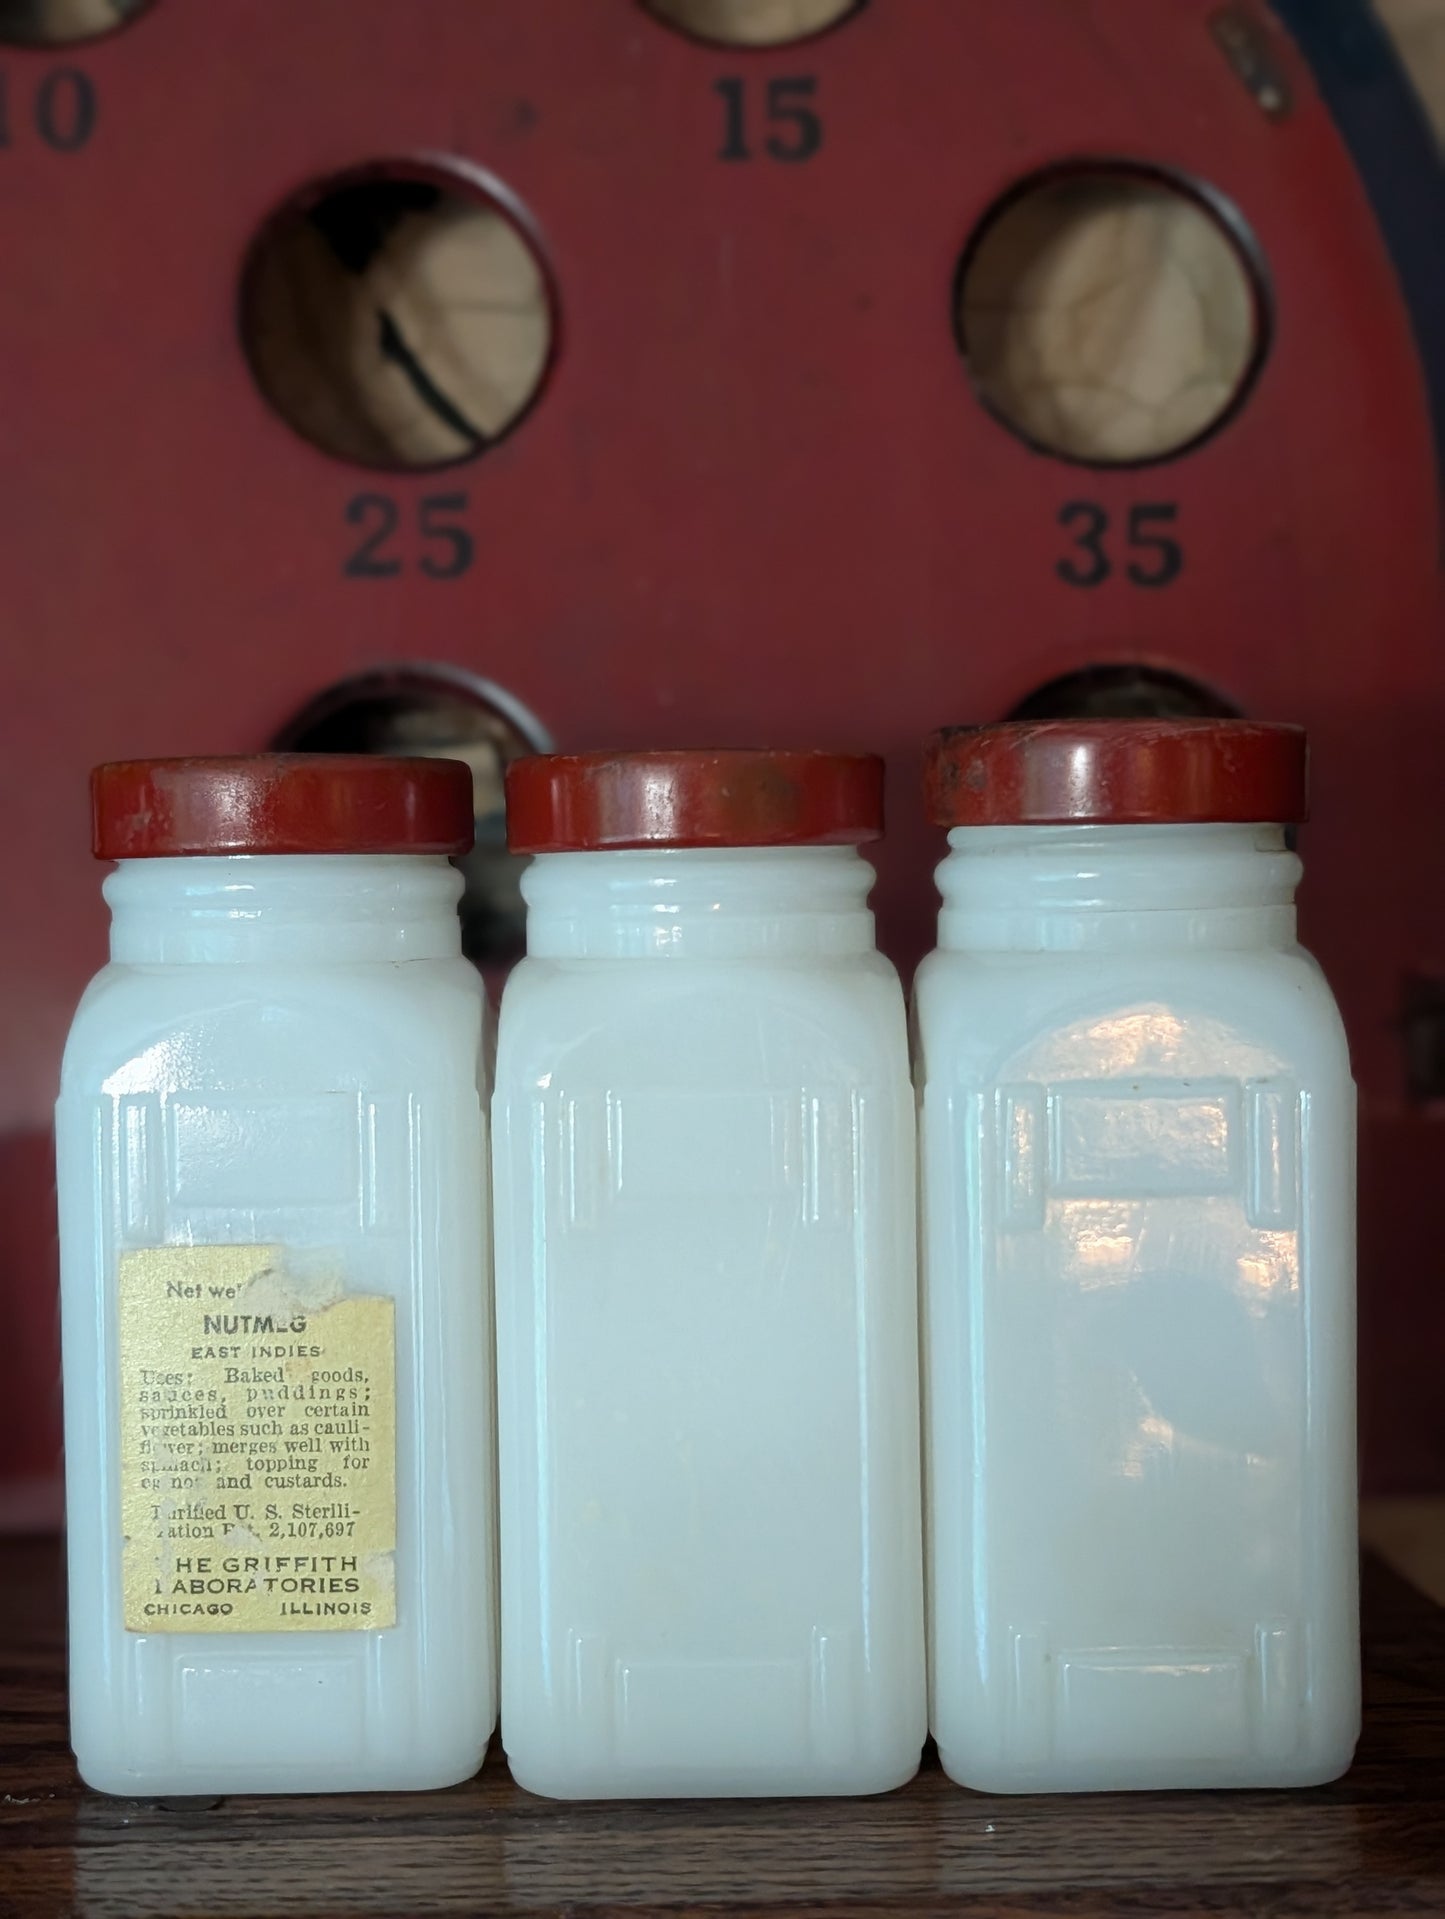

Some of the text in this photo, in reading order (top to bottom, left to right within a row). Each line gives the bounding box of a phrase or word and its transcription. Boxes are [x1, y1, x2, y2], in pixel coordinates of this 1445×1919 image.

[713, 75, 824, 163] 15
[343, 493, 475, 580] 25
[1056, 501, 1183, 587] 35
[167, 1281, 201, 1298] Net
[191, 1345, 321, 1359] EAST INDIES
[224, 1367, 283, 1384] Baked
[312, 1367, 369, 1385] goods,
[141, 1402, 370, 1420] sprinkled over certain
[240, 1421, 283, 1437] such
[290, 1424, 309, 1436] as
[314, 1419, 370, 1434] cauli-
[212, 1441, 277, 1455] merges
[285, 1437, 322, 1452] well
[329, 1437, 370, 1452] with
[247, 1457, 318, 1472] topping
[343, 1454, 370, 1469] for
[217, 1474, 252, 1489] and
[265, 1472, 347, 1488] custards.
[233, 1505, 254, 1519] U.
[265, 1504, 282, 1519] S.
[292, 1503, 361, 1519] Sterili-
[157, 1522, 214, 1538] ation
[269, 1521, 356, 1539] 2,107,697
[155, 1556, 358, 1573] HE GRIFFITH
[144, 1602, 372, 1616] CHICAGO ILLINOIS
